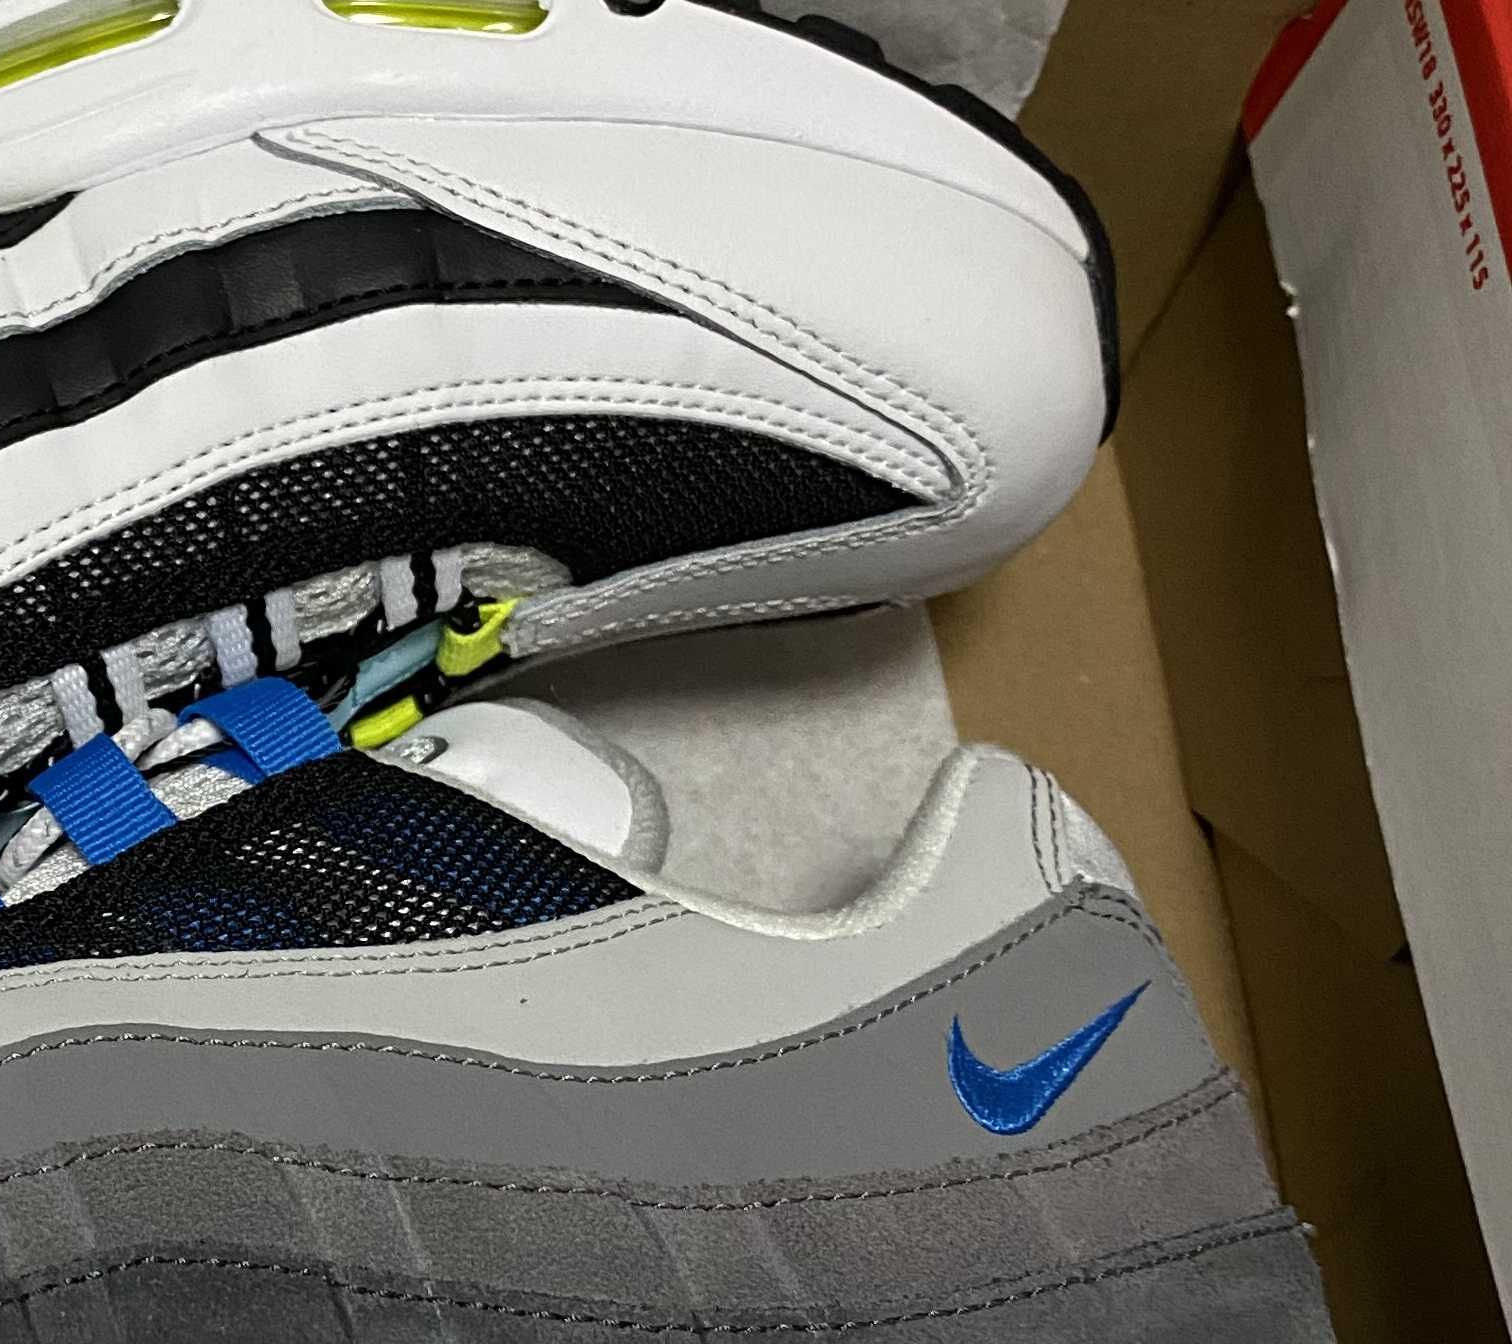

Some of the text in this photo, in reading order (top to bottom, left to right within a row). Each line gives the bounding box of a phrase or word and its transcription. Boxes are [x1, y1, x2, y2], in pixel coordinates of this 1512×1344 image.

[1429, 81, 1453, 136] 330
[1446, 155, 1471, 212] 225
[1464, 234, 1488, 290] 115
